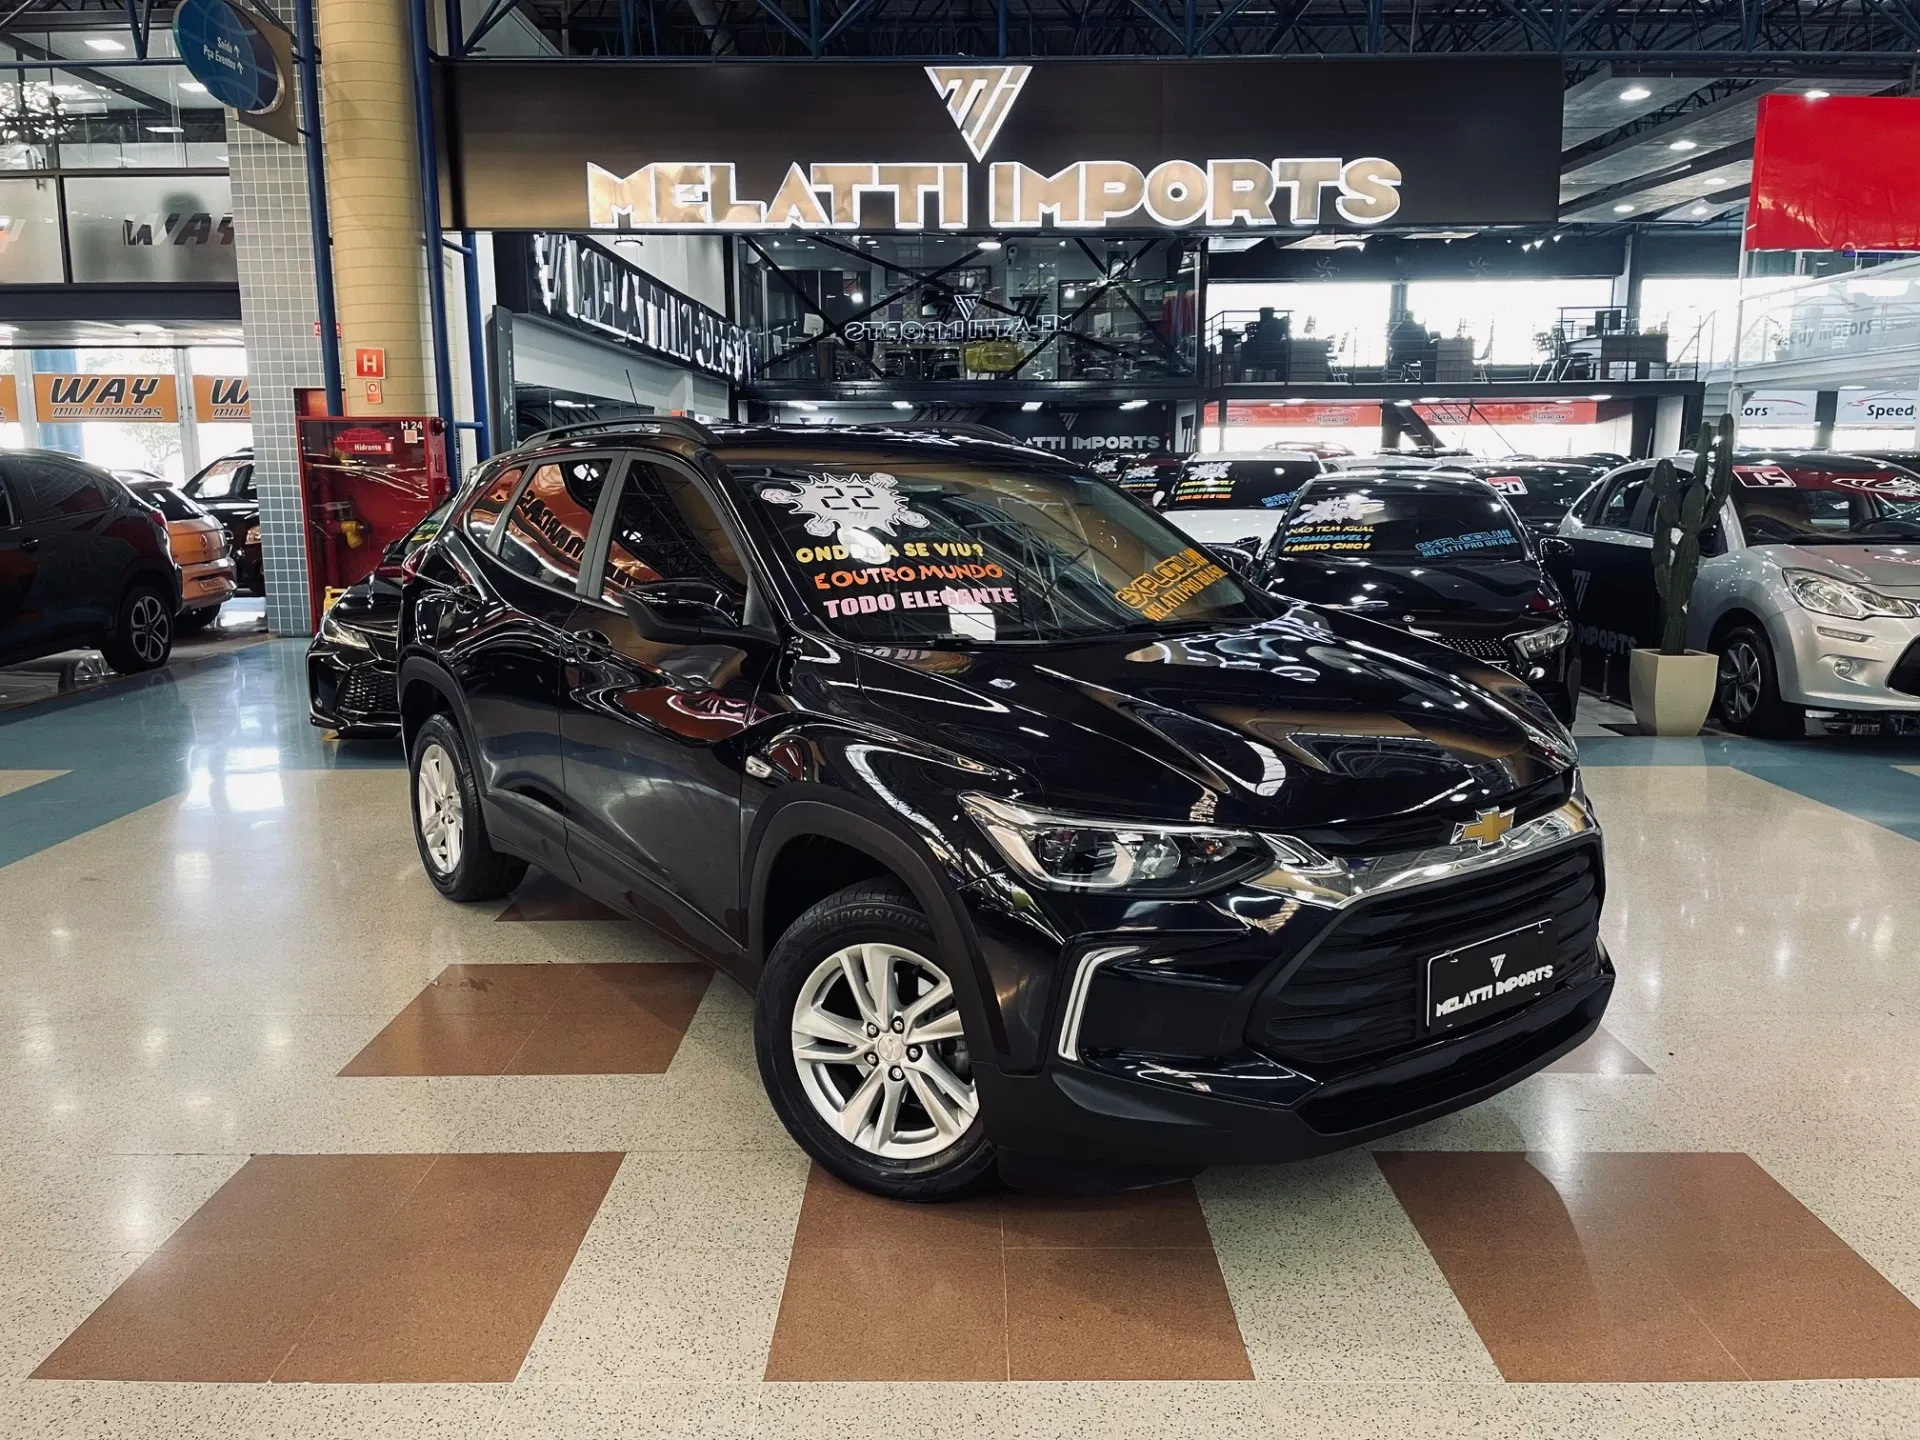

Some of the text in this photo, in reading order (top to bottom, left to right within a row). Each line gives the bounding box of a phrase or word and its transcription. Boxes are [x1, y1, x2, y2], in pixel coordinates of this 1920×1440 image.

[586, 157, 1402, 229] MELATTI IMPORTS
[362, 354, 377, 373] H
[50, 376, 160, 405] WAY
[411, 421, 423, 430] 24
[1072, 436, 1160, 450] IMPORTS
[815, 485, 880, 511] 22
[1315, 525, 1340, 534] TEM
[1342, 525, 1375, 533] IGUAL
[903, 542, 930, 558] SE
[933, 542, 984, 558] VIU?
[1291, 543, 1331, 552] MUITO
[1421, 545, 1463, 558] MELATTI
[1463, 541, 1484, 551] PRO
[831, 565, 916, 588] OUTRO
[918, 562, 1004, 581] MUNDO
[1178, 577, 1204, 598] PRO
[822, 586, 1018, 619] TODO ELEGANTE
[1435, 983, 1494, 1018] MELATTI
[1495, 964, 1554, 997] IMPORTS
